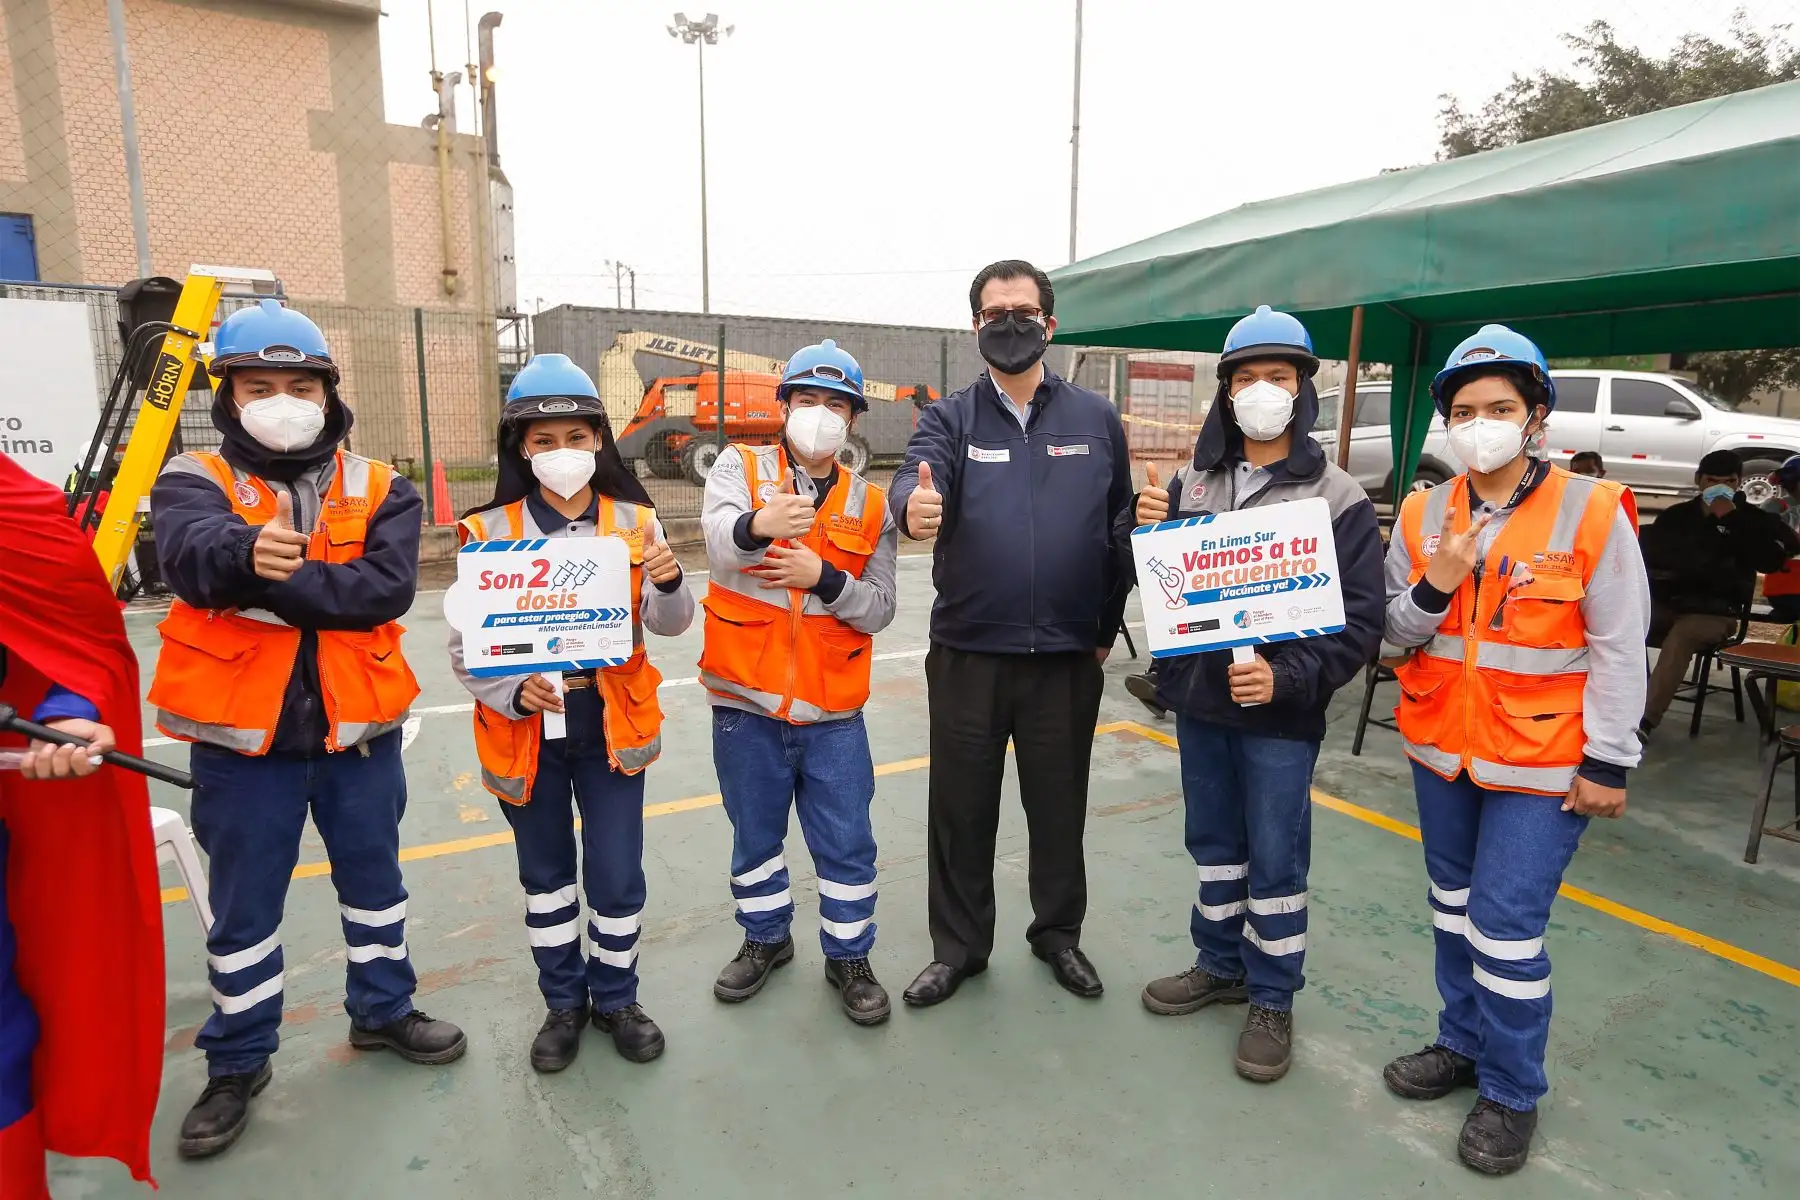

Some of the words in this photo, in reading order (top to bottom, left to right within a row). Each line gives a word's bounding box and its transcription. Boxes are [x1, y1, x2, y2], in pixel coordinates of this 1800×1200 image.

[646, 338, 678, 352] JLG
[680, 344, 717, 361] LIFT
[1201, 540, 1216, 551] En
[1220, 534, 1251, 548] Lima
[1254, 530, 1276, 542] Sur
[1183, 546, 1263, 572] Vamos
[1269, 543, 1285, 560] a
[1291, 537, 1318, 556] tu
[479, 570, 524, 591] Son
[527, 558, 551, 589] 2
[1191, 557, 1317, 590] encuentro
[516, 588, 578, 611] dosis
[1219, 582, 1271, 601] ¡Vacúnate
[1272, 580, 1289, 595] ya!
[493, 616, 517, 626] para
[518, 614, 543, 623] estar
[544, 610, 591, 625] protegido
